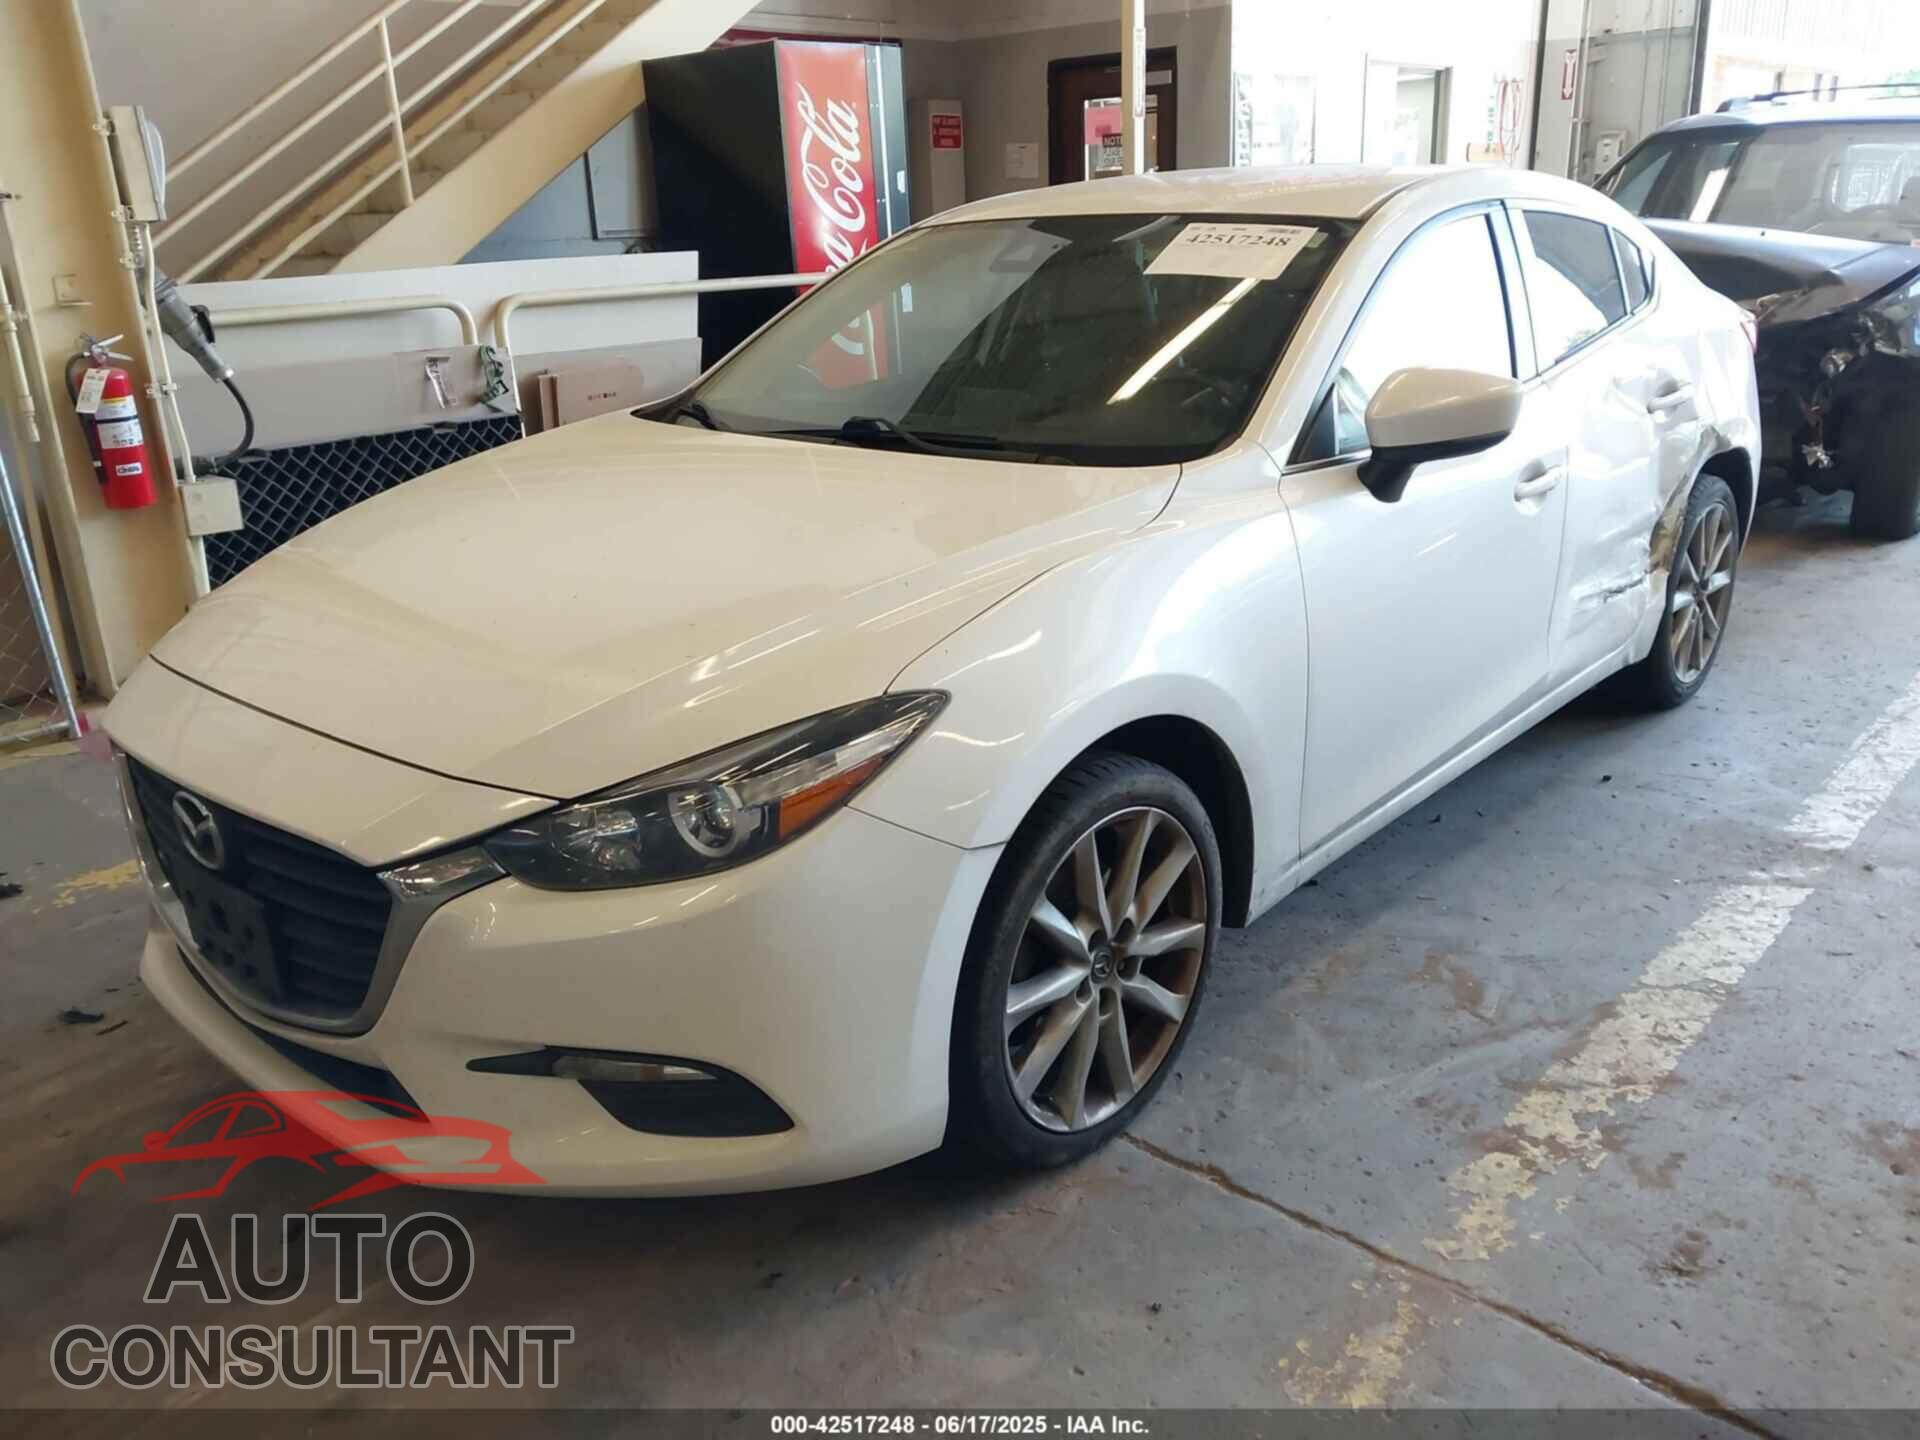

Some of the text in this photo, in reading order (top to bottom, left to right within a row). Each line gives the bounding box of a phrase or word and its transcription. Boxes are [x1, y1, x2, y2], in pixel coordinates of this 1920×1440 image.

[1104, 136, 1121, 145] NOT
[795, 81, 869, 274] a-Cola
[1186, 232, 1292, 247] 42517248
